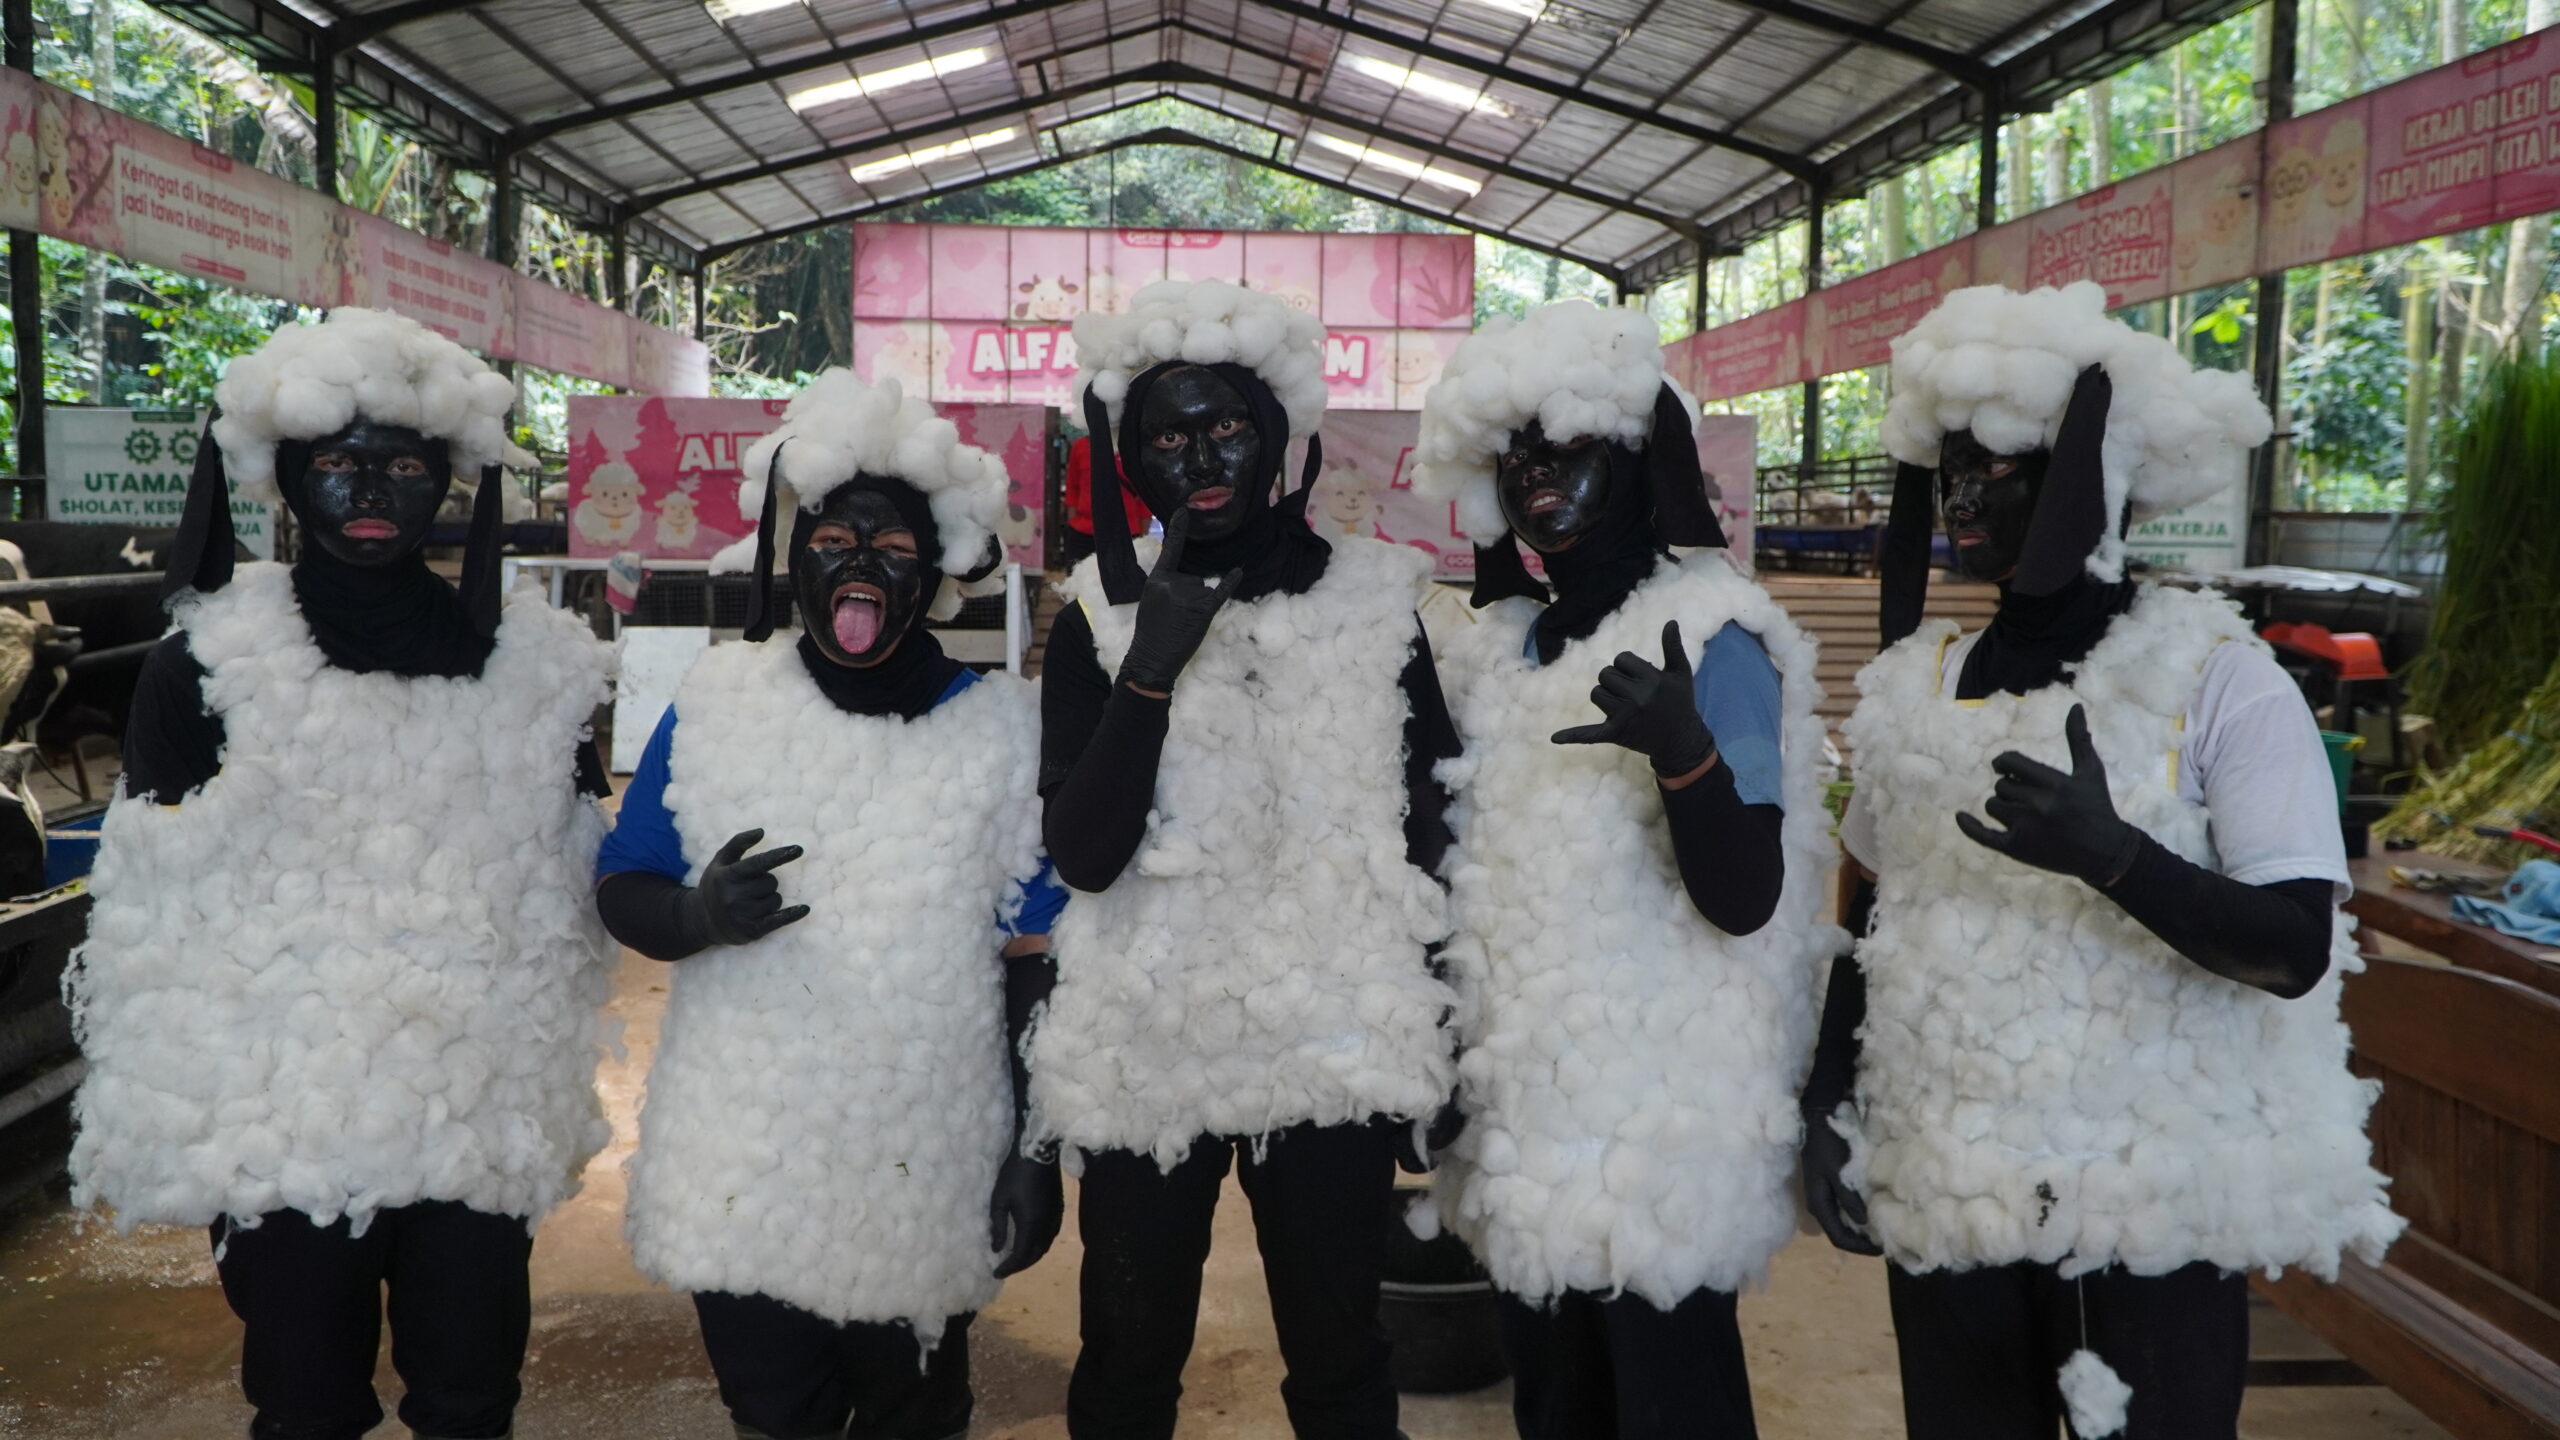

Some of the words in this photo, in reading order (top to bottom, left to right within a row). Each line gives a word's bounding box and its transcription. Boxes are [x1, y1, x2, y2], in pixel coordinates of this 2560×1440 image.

[2405, 105, 2465, 154] KERJA
[2473, 81, 2541, 132] BOLEH
[120, 158, 180, 198] Keringat
[182, 180, 194, 200] di
[196, 185, 250, 228] kandang
[252, 204, 274, 228] hari
[2378, 165, 2420, 203] TAPI
[2426, 146, 2485, 193] MIMPI
[2494, 130, 2541, 174] KITA
[121, 186, 148, 216] jadi
[150, 198, 184, 227] tawa
[187, 210, 242, 249] keluarga
[243, 234, 269, 255] esok
[271, 239, 293, 262] hari
[2098, 245, 2162, 283] REZEKI
[59, 499, 139, 517] SHOLAT,
[2169, 521, 2228, 536] KERJA
